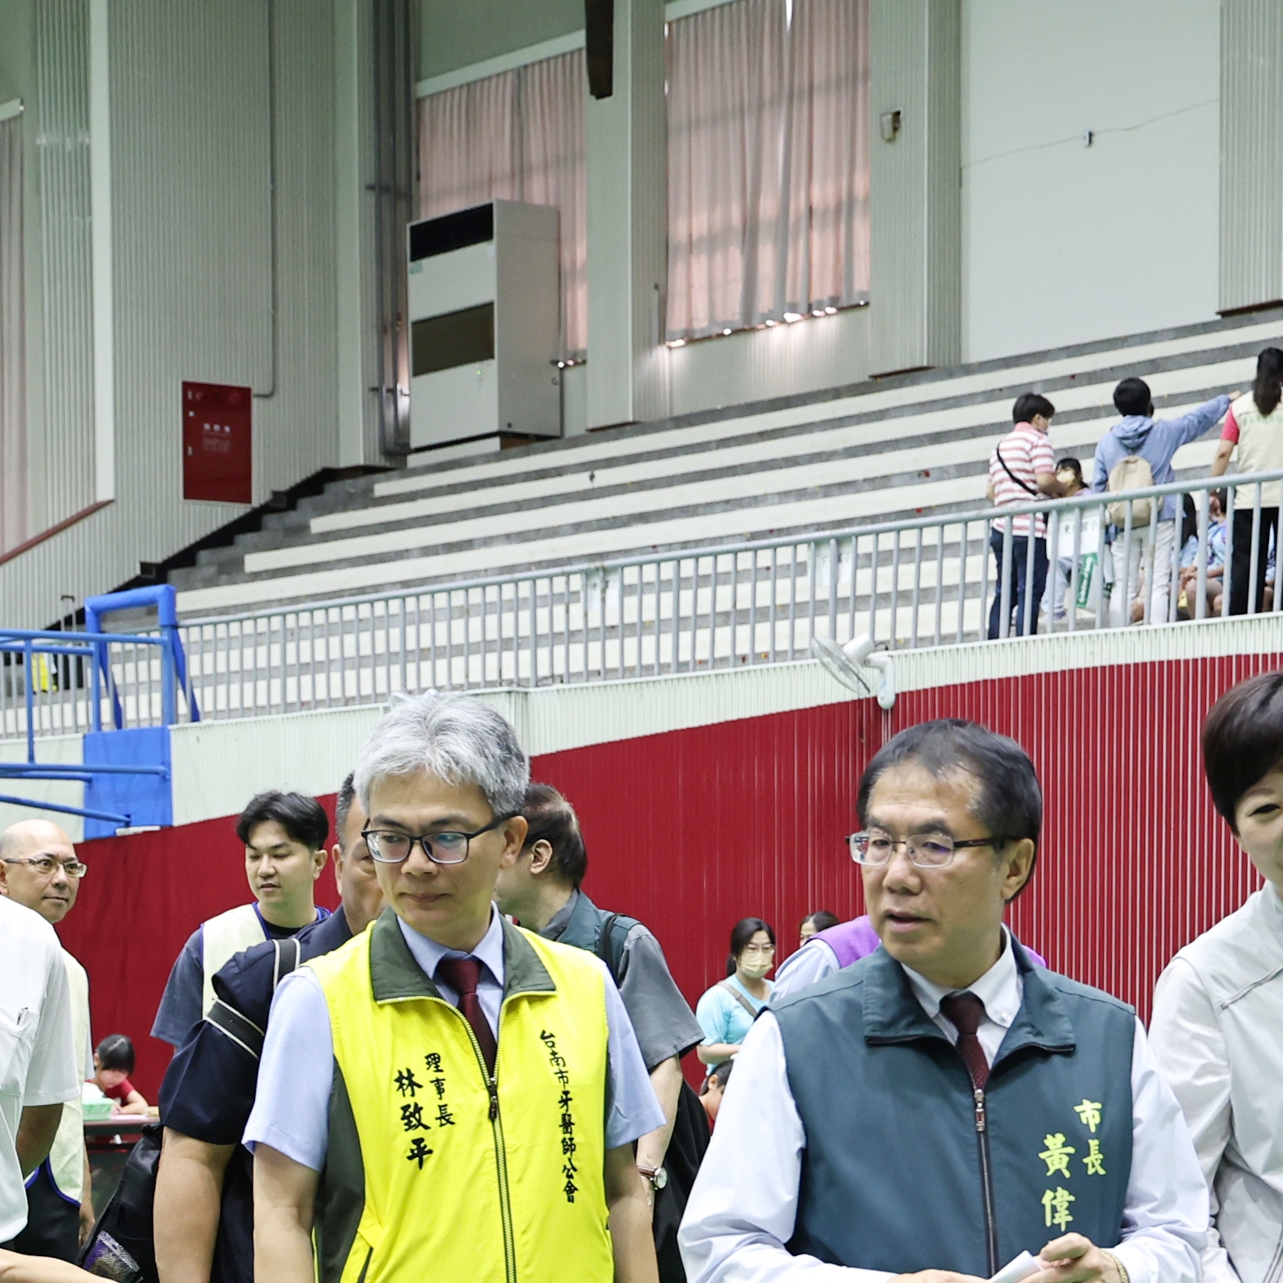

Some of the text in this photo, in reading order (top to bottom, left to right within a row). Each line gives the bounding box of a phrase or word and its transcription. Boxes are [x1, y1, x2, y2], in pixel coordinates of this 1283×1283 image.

[394, 1067, 434, 1171] 林致平
[424, 1052, 456, 1128] 理事長
[539, 1029, 579, 1204] 台南市牙醫師公會
[1073, 1098, 1107, 1176] 市長
[1038, 1132, 1076, 1244] 黃偉
